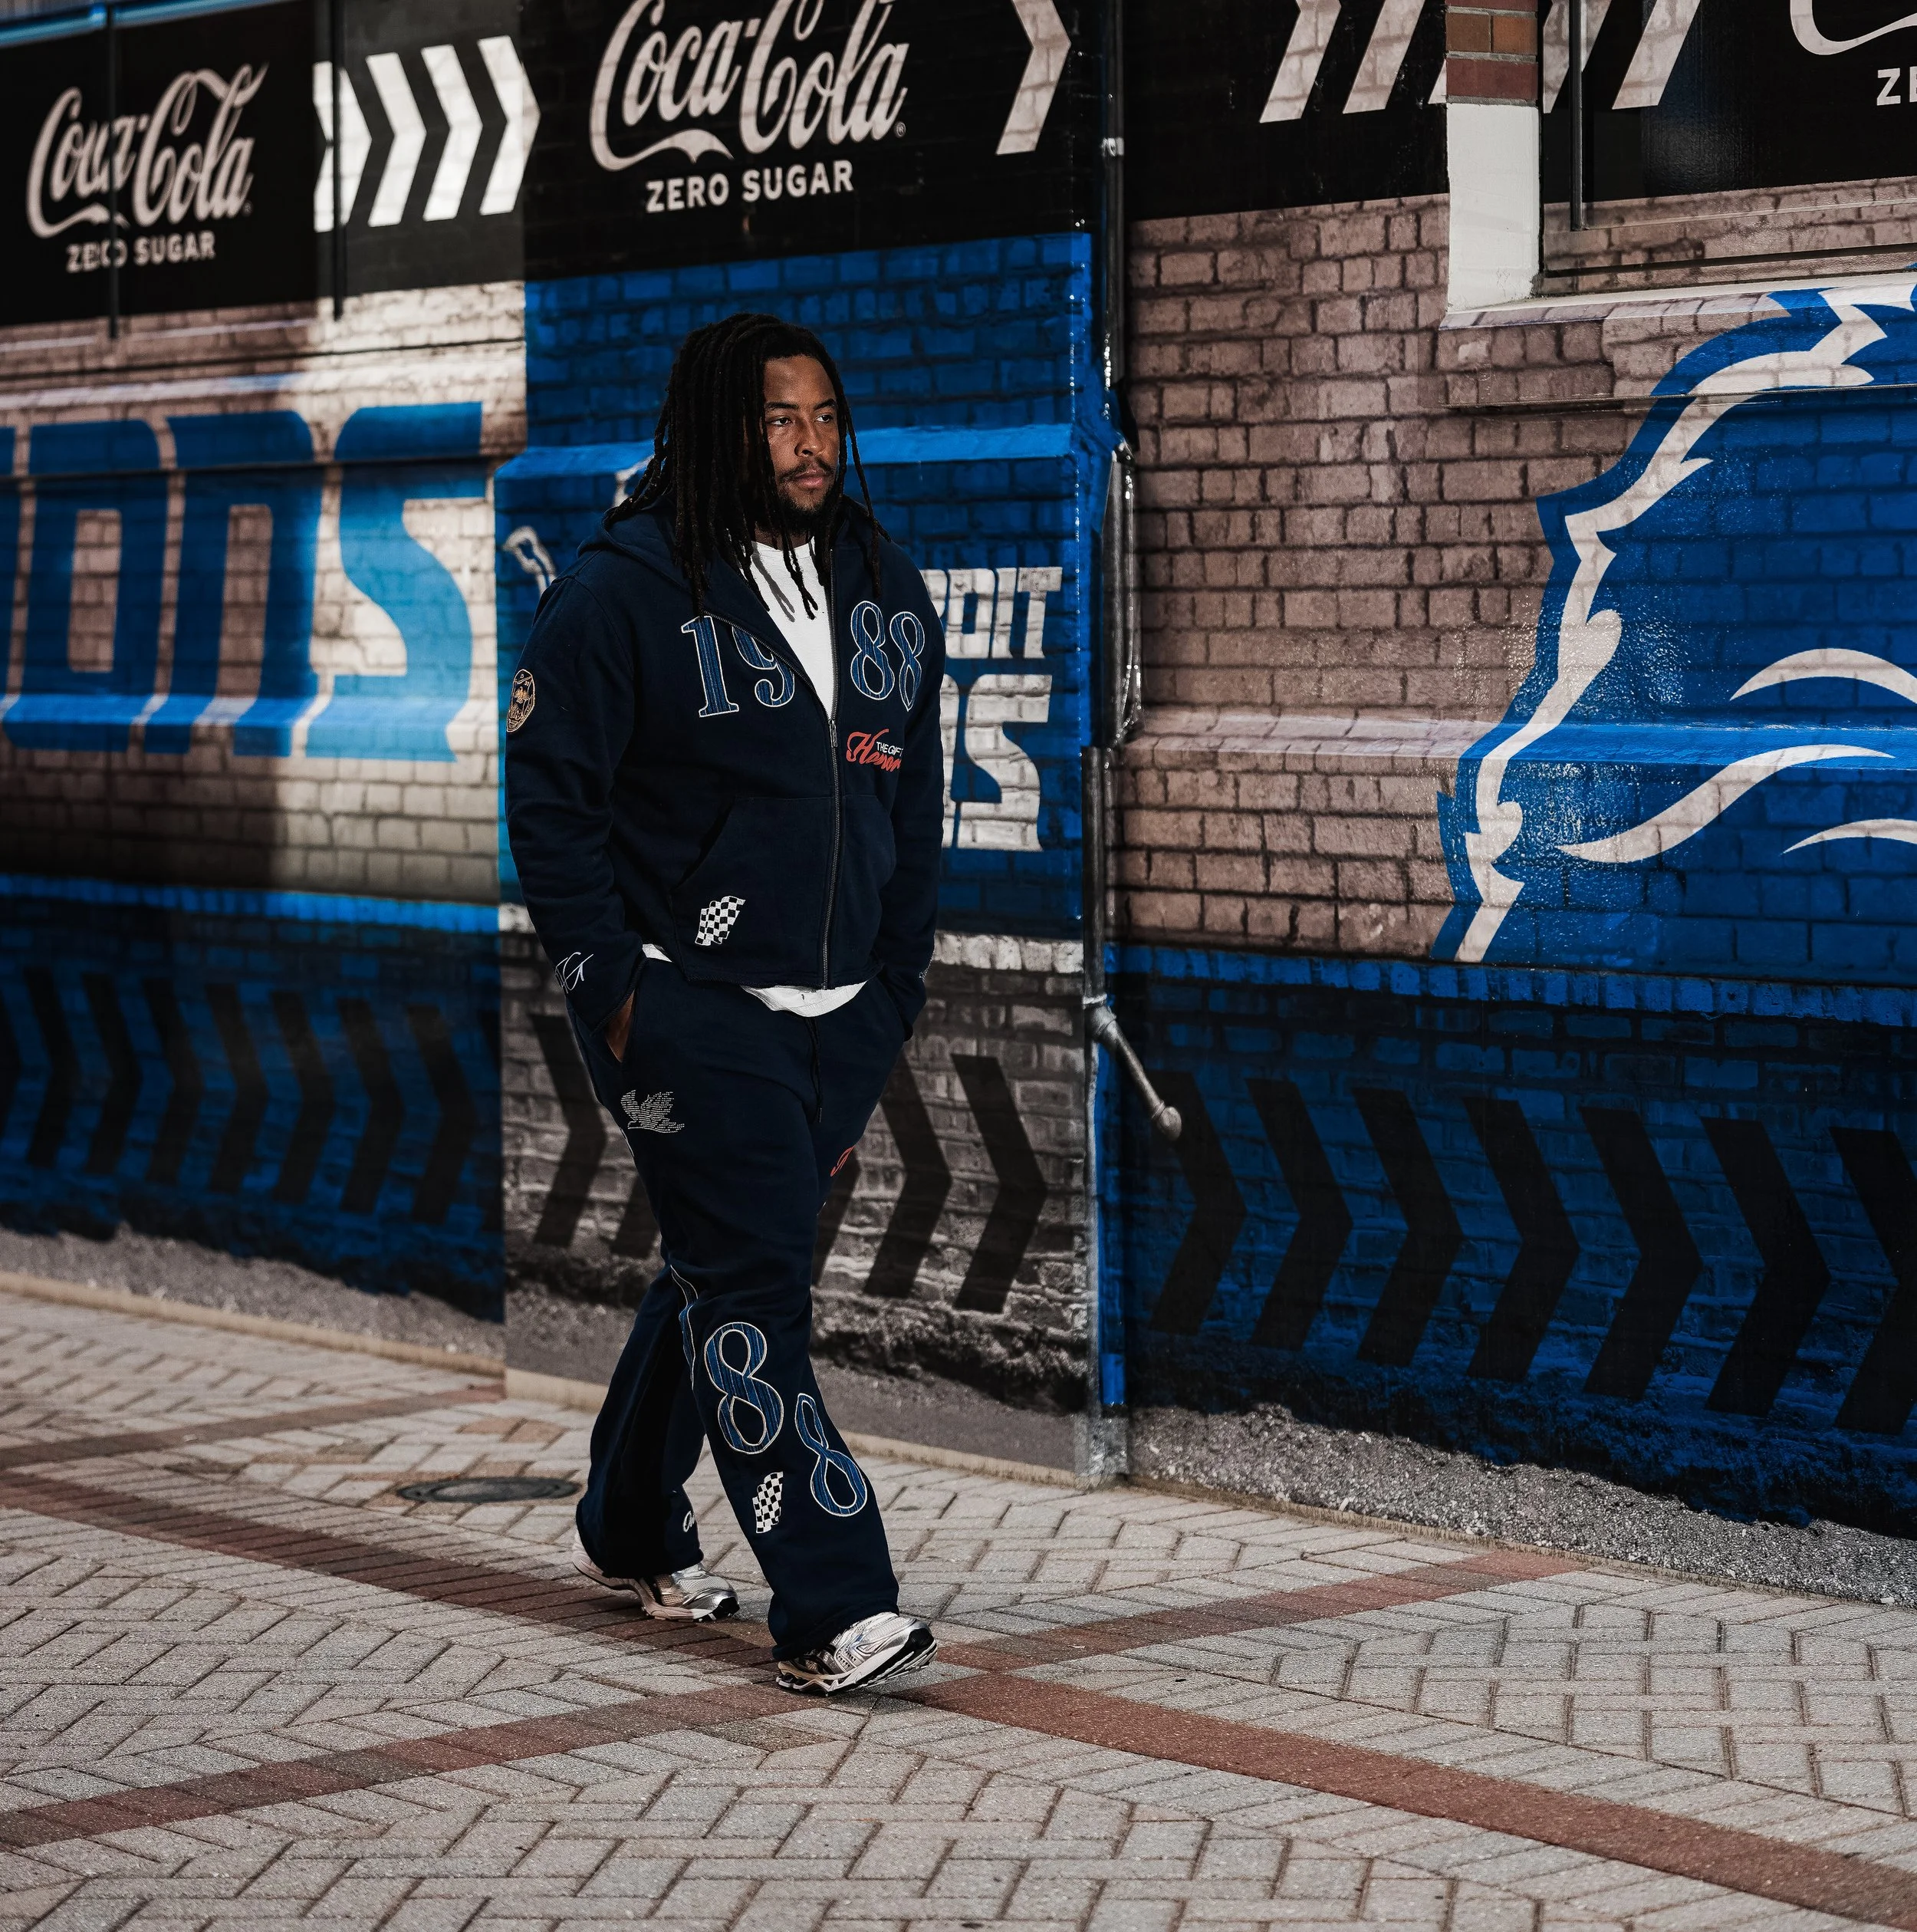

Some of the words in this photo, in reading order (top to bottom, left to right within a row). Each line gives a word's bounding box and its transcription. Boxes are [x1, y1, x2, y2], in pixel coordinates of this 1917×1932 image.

[645, 173, 730, 214] ZERO
[741, 160, 854, 202] SUGAR
[133, 230, 215, 267] SUGAR
